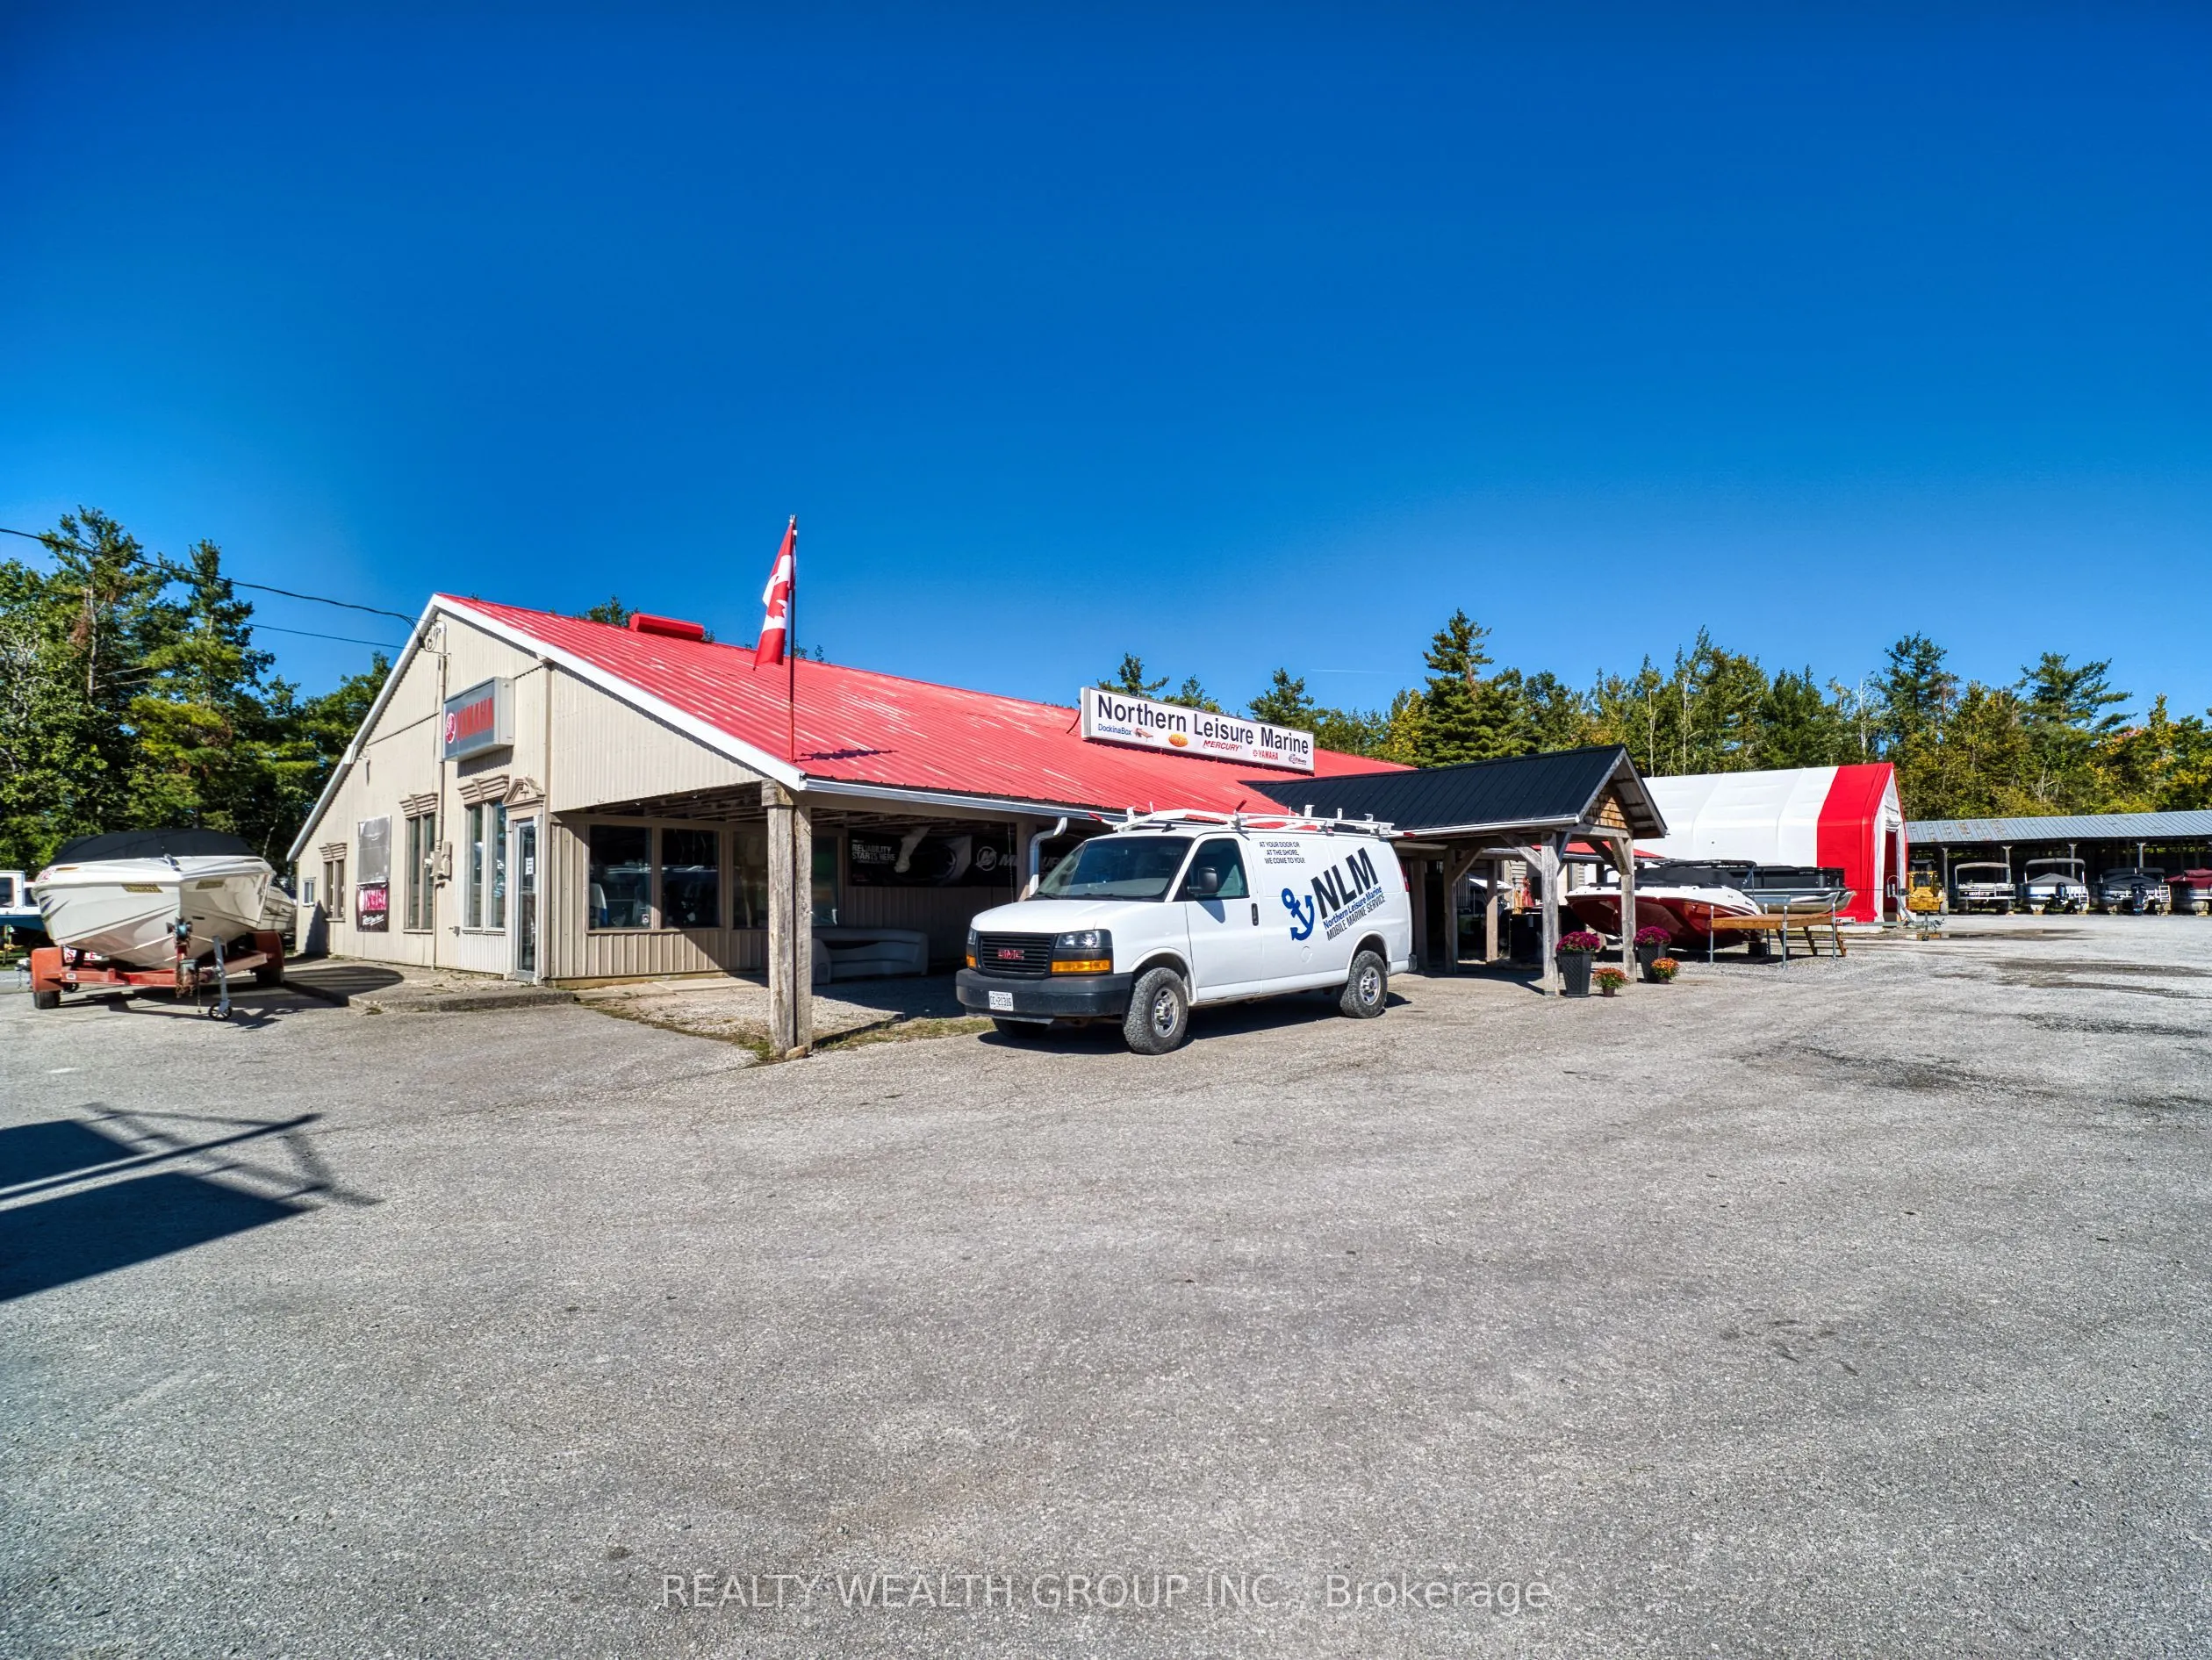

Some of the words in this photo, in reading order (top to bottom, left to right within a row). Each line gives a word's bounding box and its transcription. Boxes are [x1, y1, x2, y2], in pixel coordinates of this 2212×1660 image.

[1097, 693, 1187, 733] Northern
[1194, 713, 1254, 745] Leisure
[1260, 726, 1309, 755] Marine
[1203, 739, 1240, 752] MERCURY
[1258, 749, 1279, 760] YAMAHA
[851, 844, 893, 854] RELIABILITY
[851, 852, 878, 861] STARTS
[1311, 847, 1379, 920] NLM
[1323, 909, 1349, 930] Northern
[1347, 897, 1367, 914] Leisure
[1365, 887, 1382, 902] Marine
[1326, 919, 1348, 941] MOBILE
[1347, 907, 1368, 927] MARINE
[1366, 892, 1386, 914] SERVICE
[997, 949, 1024, 961] GMC
